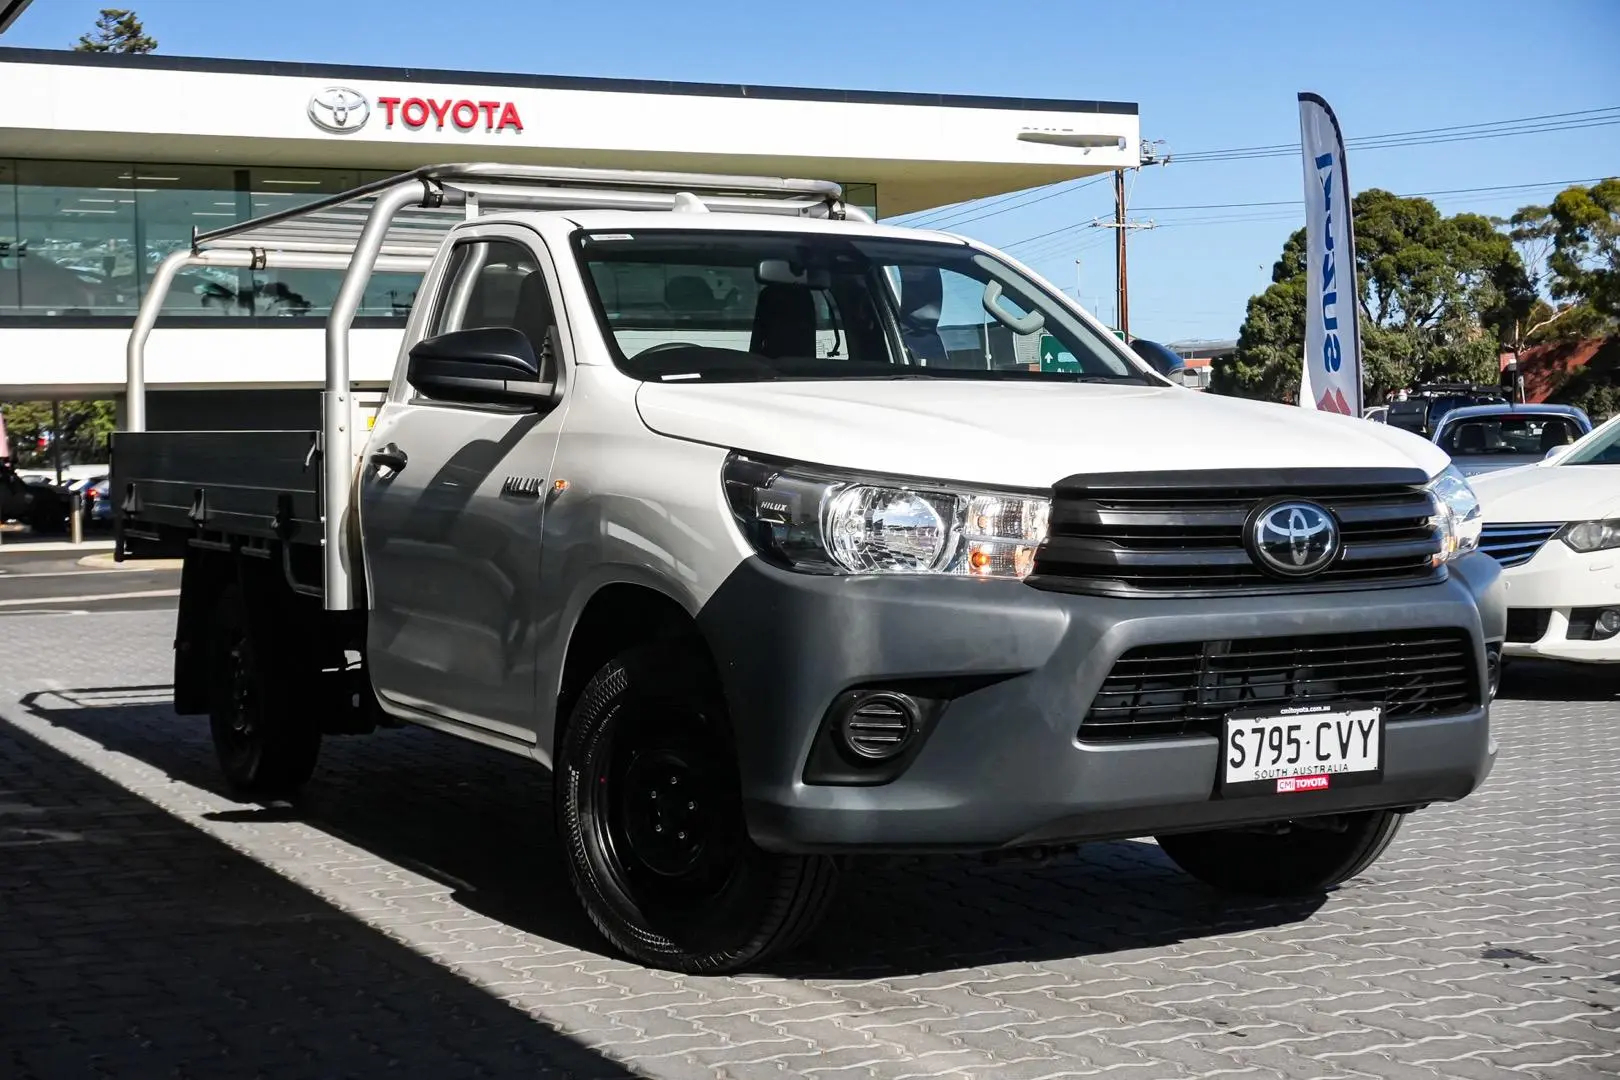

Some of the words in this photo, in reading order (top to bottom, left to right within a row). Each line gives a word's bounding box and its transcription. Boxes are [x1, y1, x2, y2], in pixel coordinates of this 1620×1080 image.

[378, 96, 524, 131] TOYOTA
[501, 476, 544, 495] HILUX
[760, 501, 787, 511] HILUX
[1254, 768, 1288, 780] SOUTH
[1292, 763, 1349, 776] AUSTRALIA
[1295, 777, 1329, 789] TOYOTA
